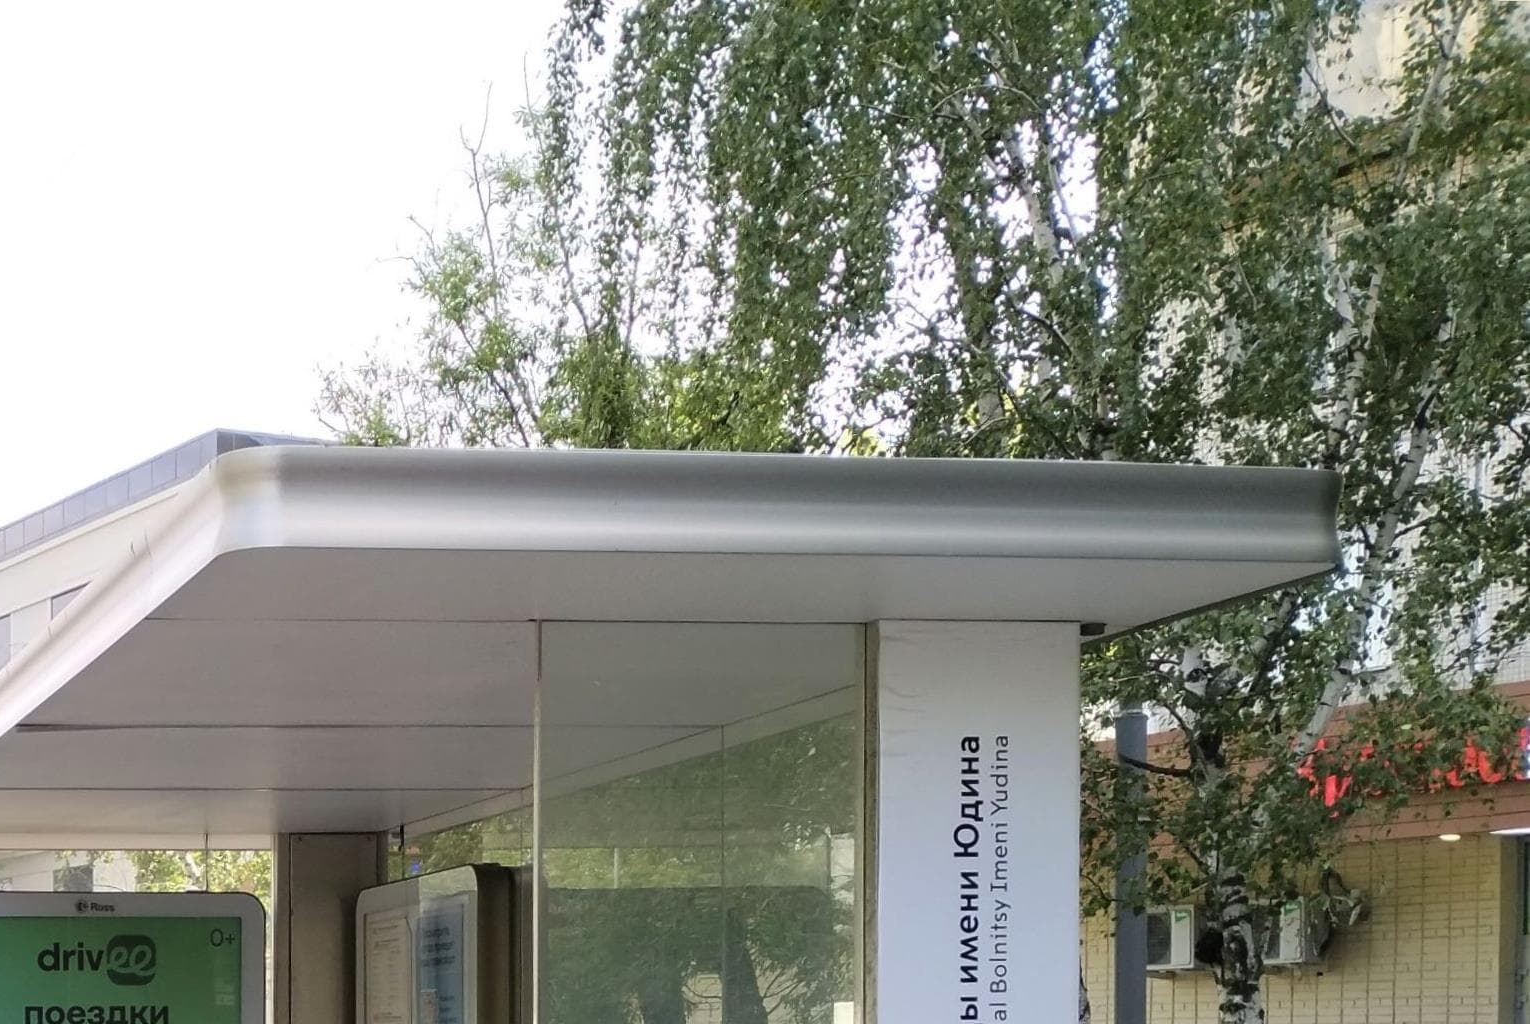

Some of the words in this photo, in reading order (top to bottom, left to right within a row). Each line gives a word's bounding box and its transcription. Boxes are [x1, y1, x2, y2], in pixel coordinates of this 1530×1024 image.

[953, 735, 984, 858] Юдина
[989, 735, 1009, 817] Yudina
[989, 822, 1008, 893] Imeni
[37, 934, 157, 986] drivee
[210, 928, 236, 947] 0+
[959, 871, 979, 984] имени
[988, 899, 1012, 994] Bolnitsy
